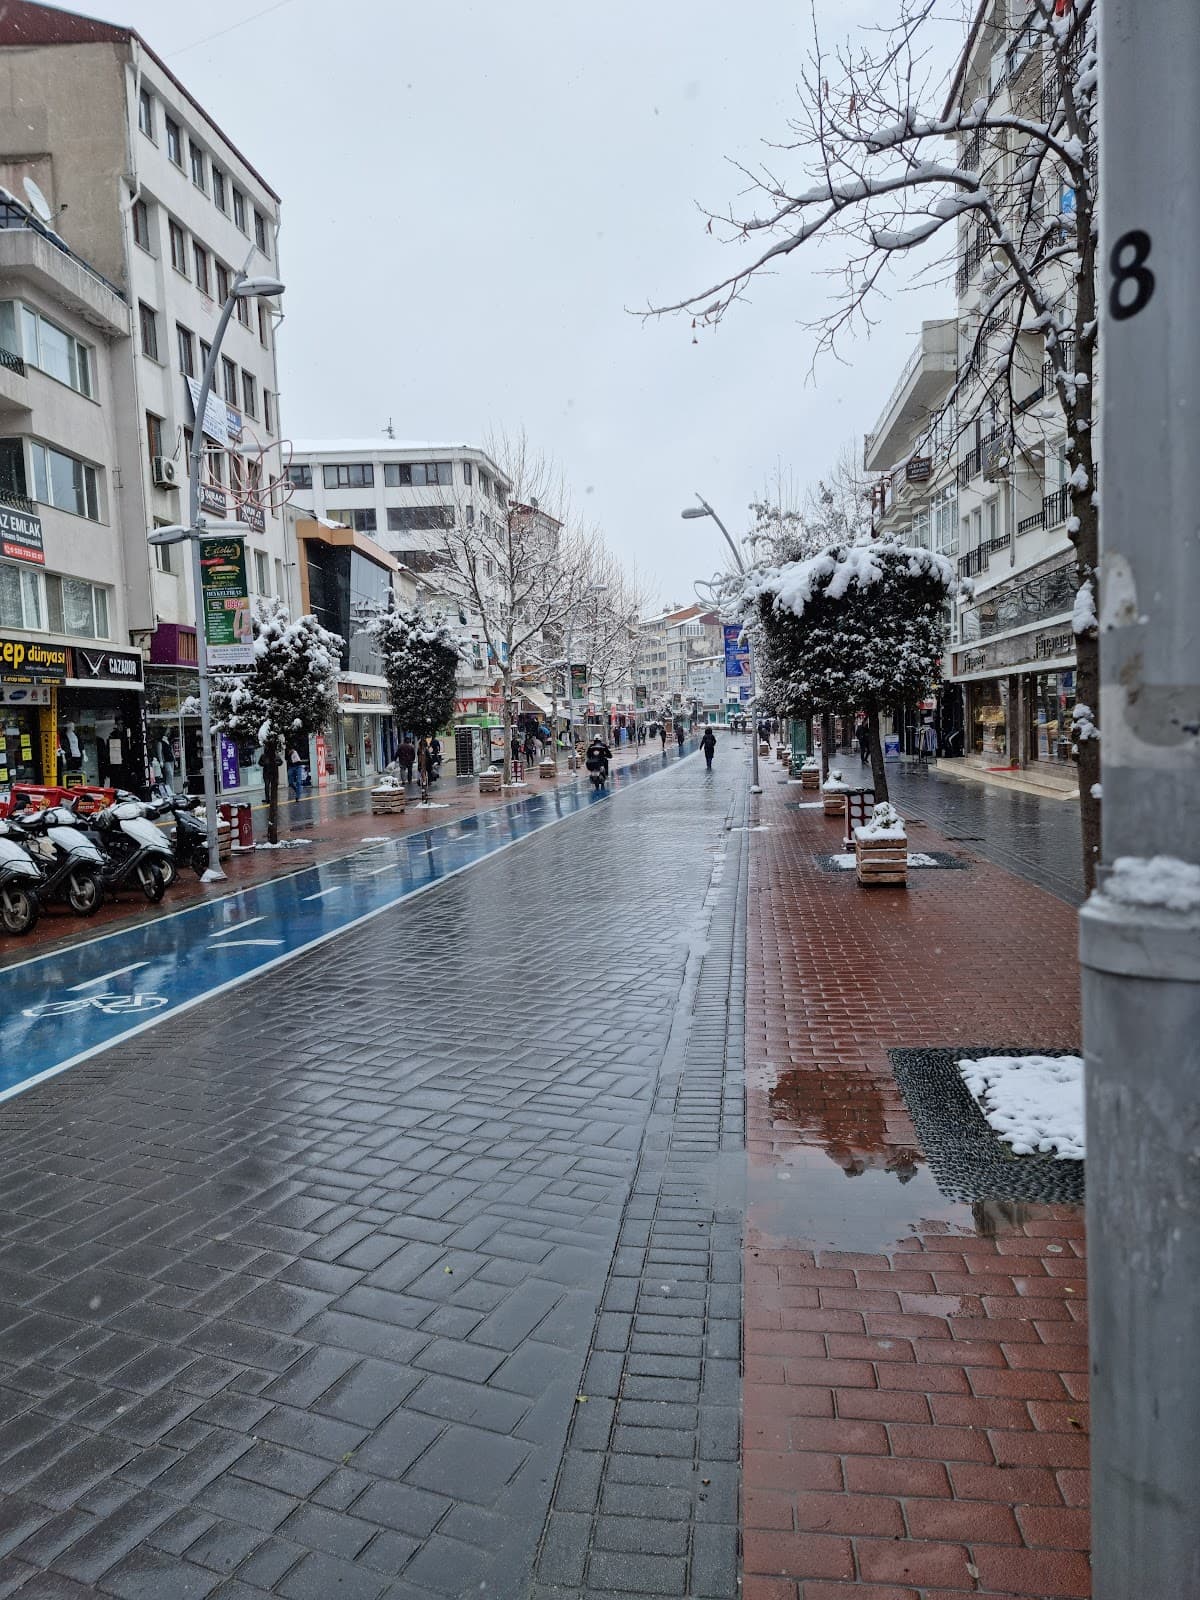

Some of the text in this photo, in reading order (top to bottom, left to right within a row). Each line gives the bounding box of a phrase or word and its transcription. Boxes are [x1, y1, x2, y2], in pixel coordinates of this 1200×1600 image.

[1109, 230, 1155, 321] 8
[10, 516, 41, 538] EMLAK
[27, 645, 65, 667] dünyası
[109, 658, 137, 675] CAZADOR
